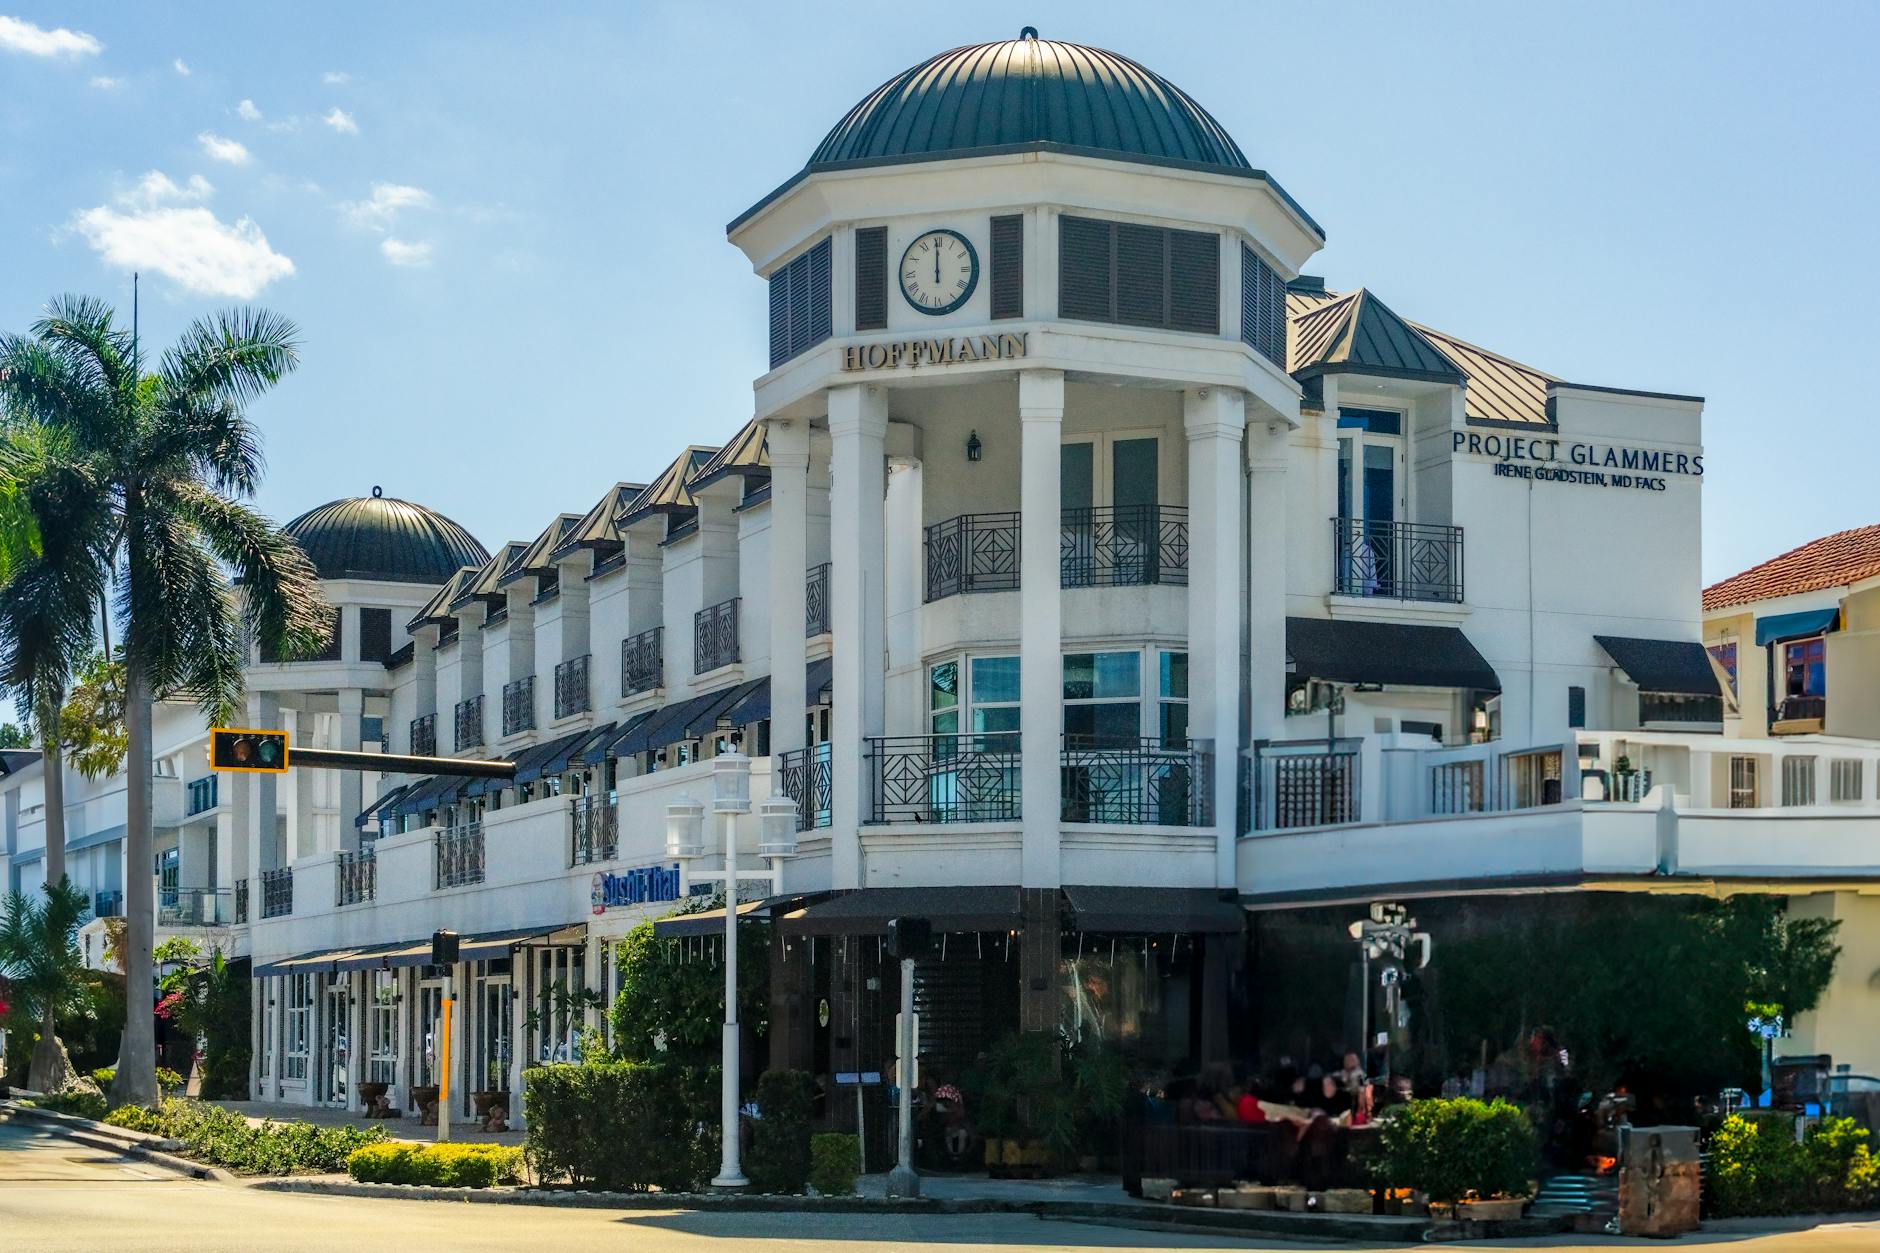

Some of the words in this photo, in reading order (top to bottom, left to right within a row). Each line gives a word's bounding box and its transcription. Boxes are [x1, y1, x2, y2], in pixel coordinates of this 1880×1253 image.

[841, 332, 1028, 372] HOFFMANN
[1453, 432, 1559, 462] PROJECT
[1571, 444, 1704, 476] GLAMMERS
[1494, 463, 1531, 479] IRENE
[1611, 474, 1632, 487] MD
[1635, 477, 1666, 491] FACS
